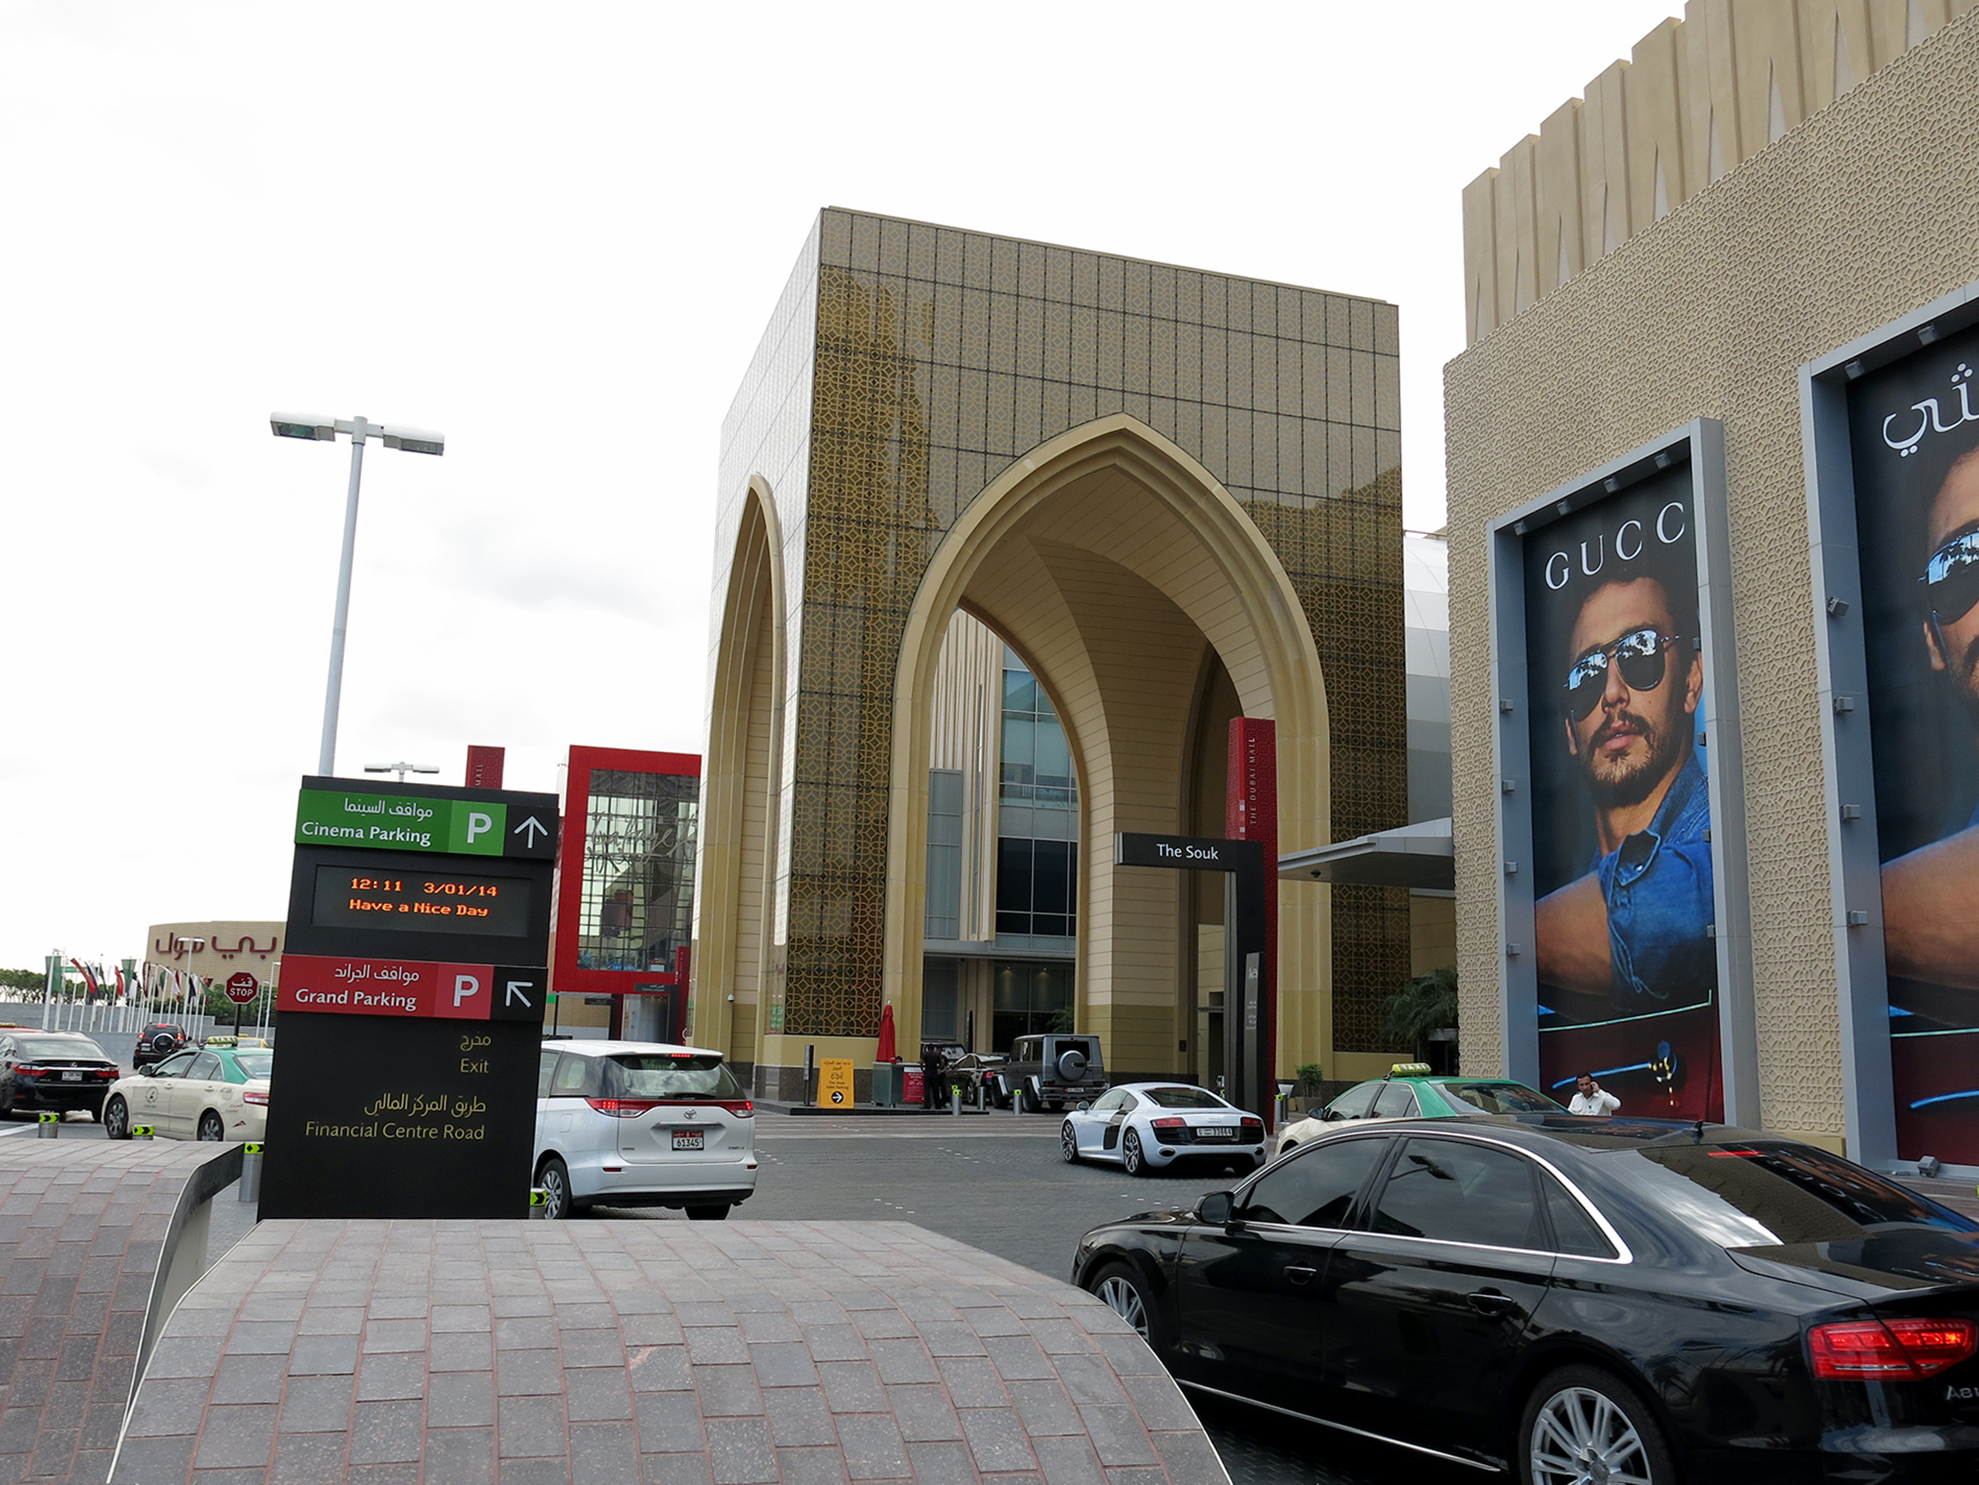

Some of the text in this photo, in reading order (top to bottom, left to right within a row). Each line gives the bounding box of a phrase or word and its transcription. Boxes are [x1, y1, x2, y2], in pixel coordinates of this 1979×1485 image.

[1544, 501, 1686, 591] GUCC
[475, 764, 483, 787] MALL
[1248, 737, 1257, 825] THE DUBAI MALL
[344, 797, 434, 822] مواقف السينما
[301, 821, 432, 847] Cinema Parking
[467, 812, 493, 844] P
[1156, 843, 1219, 860] The Souk
[350, 878, 499, 897] 12:11 3/01/14
[349, 898, 489, 917] Have a Nice Day
[211, 935, 278, 960] بي
[231, 976, 254, 987] قف
[334, 963, 420, 986] مواقف الجراند
[229, 988, 254, 997] STOP
[295, 988, 417, 1012] Grand Parking
[453, 974, 480, 1007] P
[459, 1031, 492, 1051] مخرج
[459, 1058, 490, 1074] Exit
[364, 1092, 486, 1118] طريق المركز المالي
[305, 1120, 485, 1140] Financial Centre Road
[676, 1138, 700, 1147] 61345
